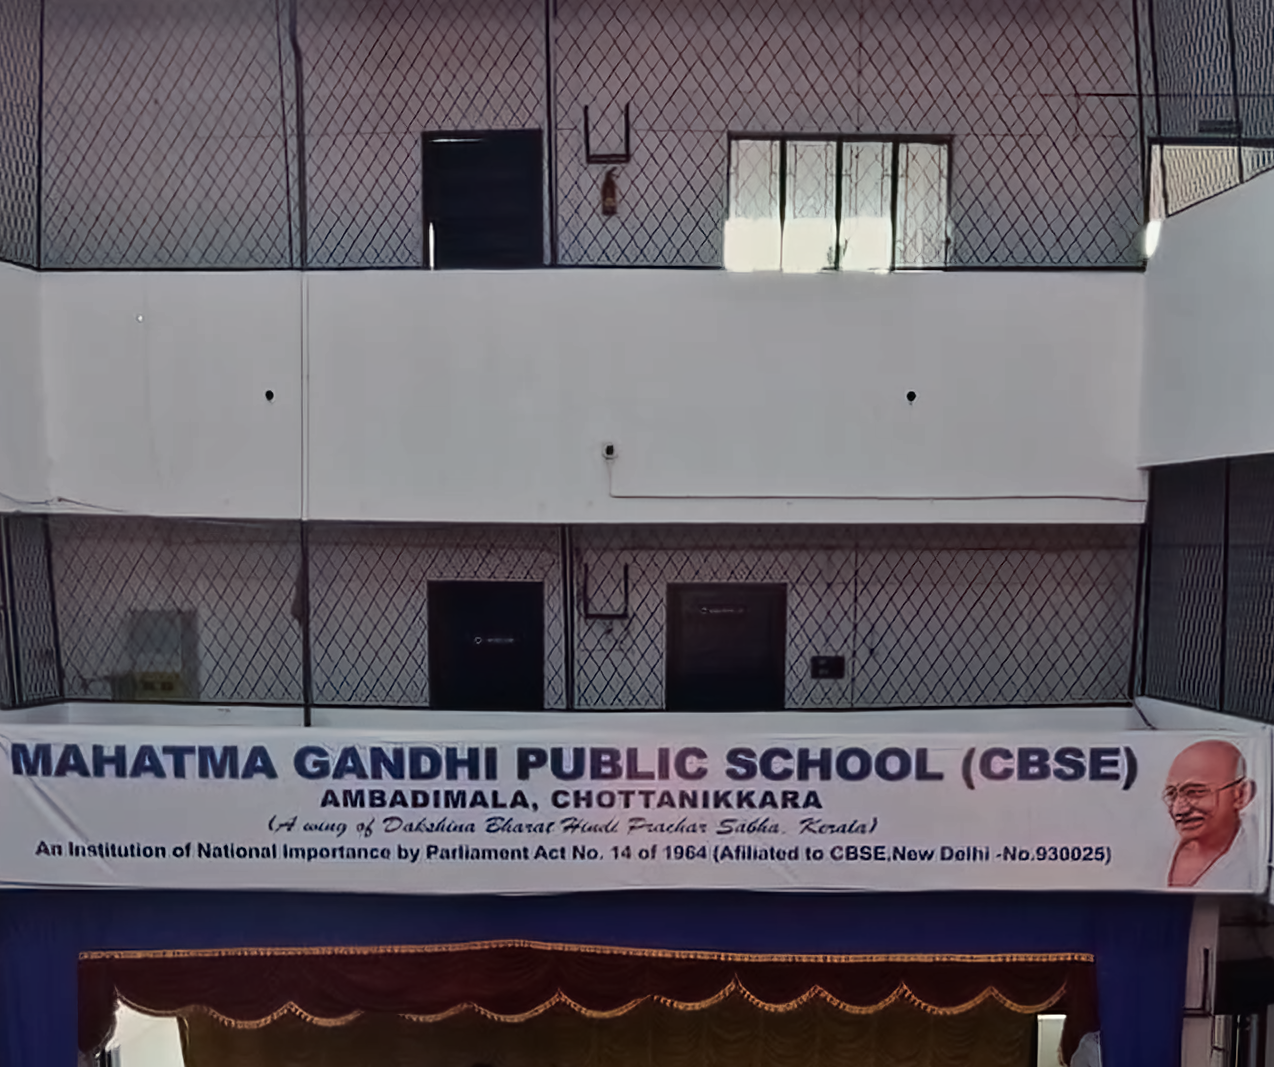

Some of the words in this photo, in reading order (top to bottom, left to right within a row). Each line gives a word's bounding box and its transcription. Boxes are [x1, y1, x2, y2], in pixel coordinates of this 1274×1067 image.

[11, 742, 279, 780] MAHATMA
[293, 745, 498, 781] GANDHI
[516, 746, 709, 782] PUBLIC
[725, 746, 944, 782] SCHOOL
[961, 745, 1138, 791] (CBSE)
[320, 788, 539, 812] AMBADIMALA,
[551, 789, 823, 809] CHOTTANIKKARA
[303, 820, 348, 838] wing
[356, 816, 376, 838] of
[382, 815, 476, 834] Dakshina
[484, 816, 555, 834] Bharat
[559, 816, 620, 834] Hindi
[626, 816, 708, 836] Prachar
[35, 840, 63, 857] An
[68, 841, 166, 859] Institution
[172, 842, 193, 859] of
[197, 842, 277, 860] National
[283, 843, 391, 863] Importance
[397, 844, 421, 864] by
[427, 844, 531, 862] Parliament
[533, 845, 567, 861] Act
[572, 845, 604, 861] No.
[611, 845, 631, 861] 14
[638, 844, 658, 861] of
[664, 845, 707, 861] 1964
[804, 846, 824, 861] to
[940, 845, 991, 862] Delhi
